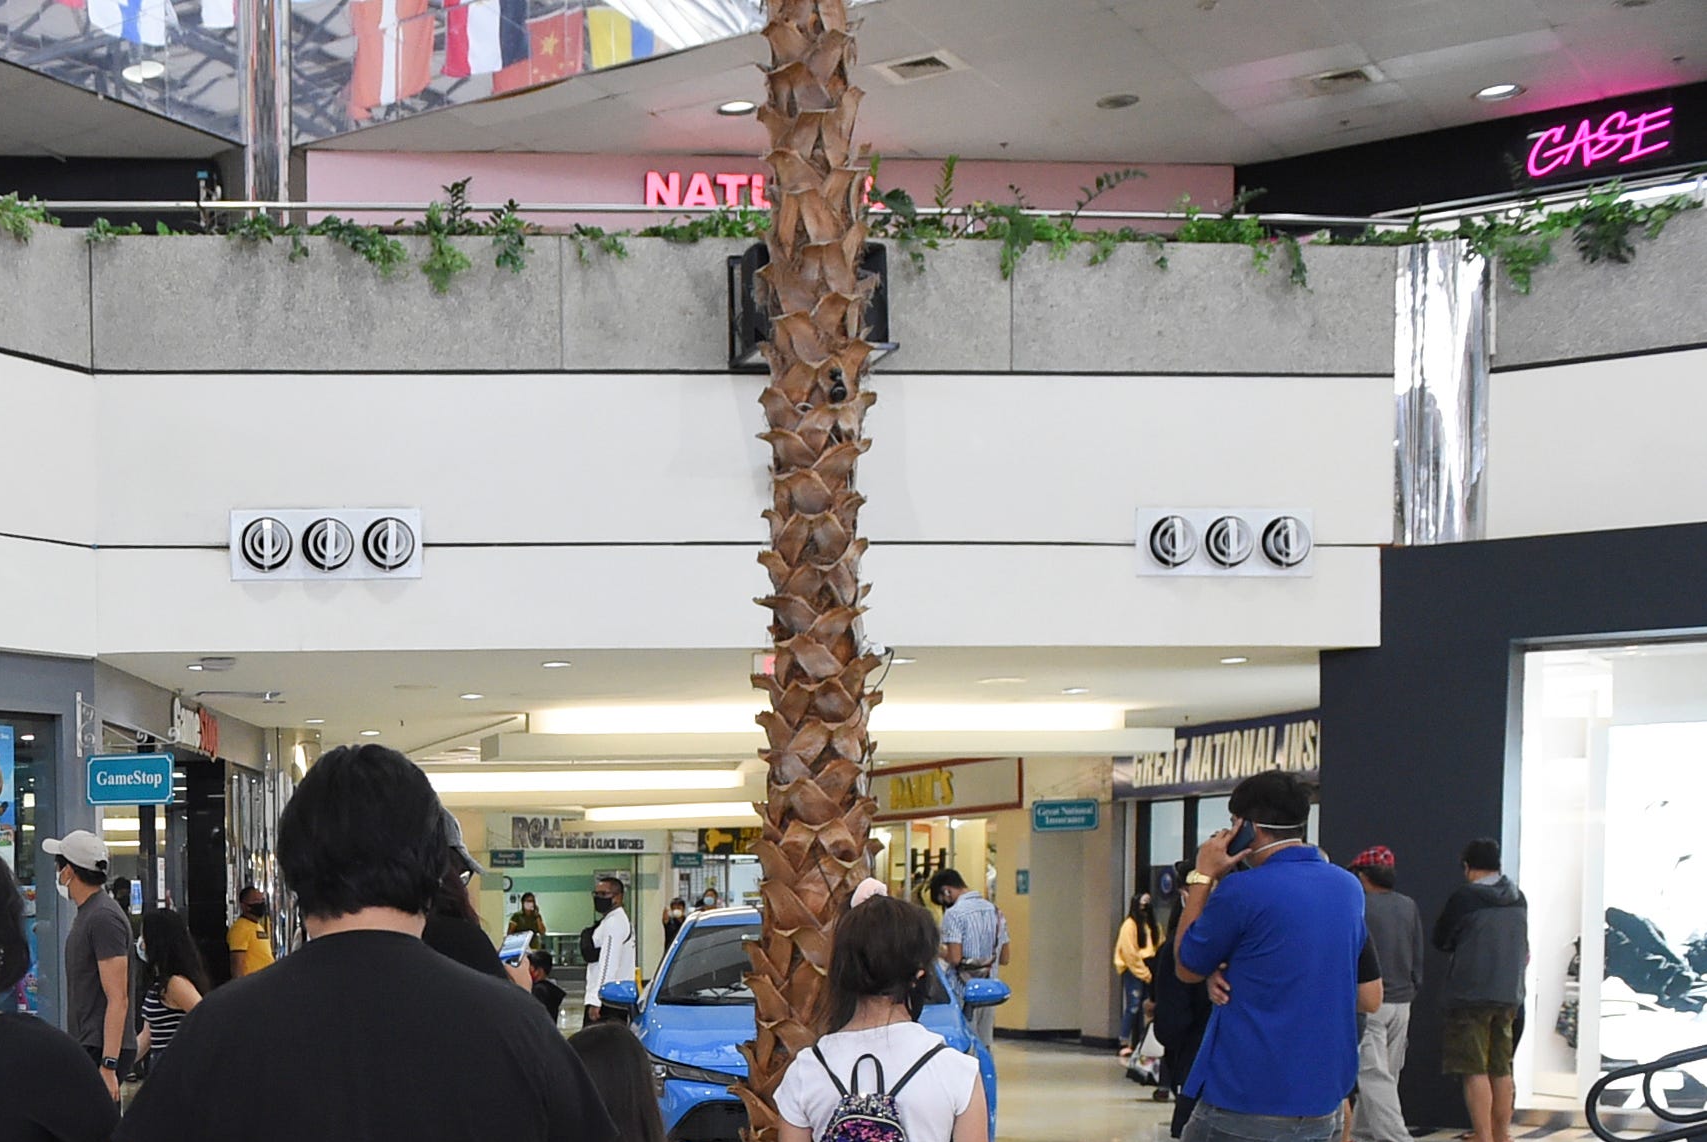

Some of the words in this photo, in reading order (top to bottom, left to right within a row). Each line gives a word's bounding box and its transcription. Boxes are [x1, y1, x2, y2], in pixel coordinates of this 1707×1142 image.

[1527, 106, 1674, 177] CASE
[1133, 738, 1188, 788] GREAT
[1188, 726, 1277, 782] NATIONAL
[1280, 719, 1320, 771] INS
[96, 770, 162, 788] GameStop
[1037, 806, 1060, 817] Great
[1061, 805, 1094, 816] National
